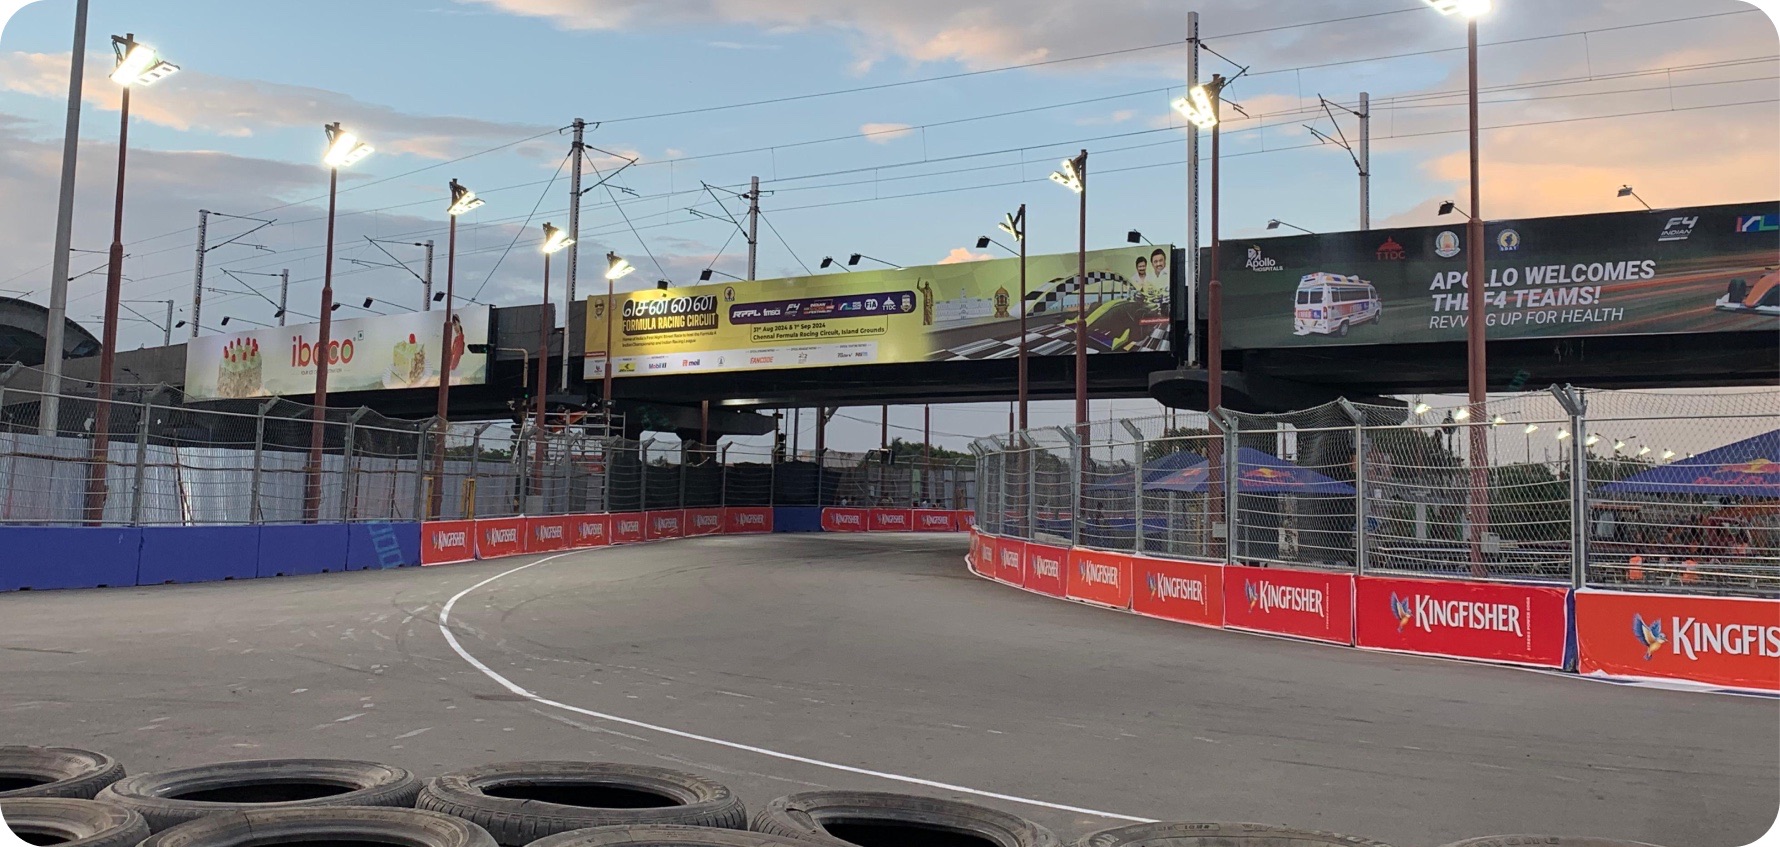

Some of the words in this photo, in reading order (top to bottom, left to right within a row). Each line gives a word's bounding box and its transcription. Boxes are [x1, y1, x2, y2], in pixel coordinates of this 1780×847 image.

[1664, 216, 1700, 230] F4
[1245, 257, 1276, 269] Apollo
[1376, 250, 1405, 260] TTDC
[1429, 267, 1518, 290] APLO
[1525, 260, 1656, 284] WELCOMES
[786, 303, 800, 311] F4
[865, 300, 877, 309] FIA
[1513, 286, 1601, 308] TEAMS!
[622, 317, 656, 332] FORMULA
[657, 315, 685, 330] RACING
[686, 313, 716, 327] CIRCUIT
[1429, 313, 1496, 329] REVVG
[1500, 312, 1522, 326] UP
[1525, 310, 1557, 324] FOR
[1560, 307, 1624, 323] HEALTH
[749, 356, 774, 364] FANCODE
[1036, 555, 1059, 580] KINGFISHER
[1086, 560, 1119, 588] KINGFISHER
[1157, 572, 1204, 606] KINGFISHER
[1260, 580, 1325, 618] KINGFISHER
[1415, 594, 1524, 637] KINGFISHER
[1672, 616, 1780, 661] KINGFIS
